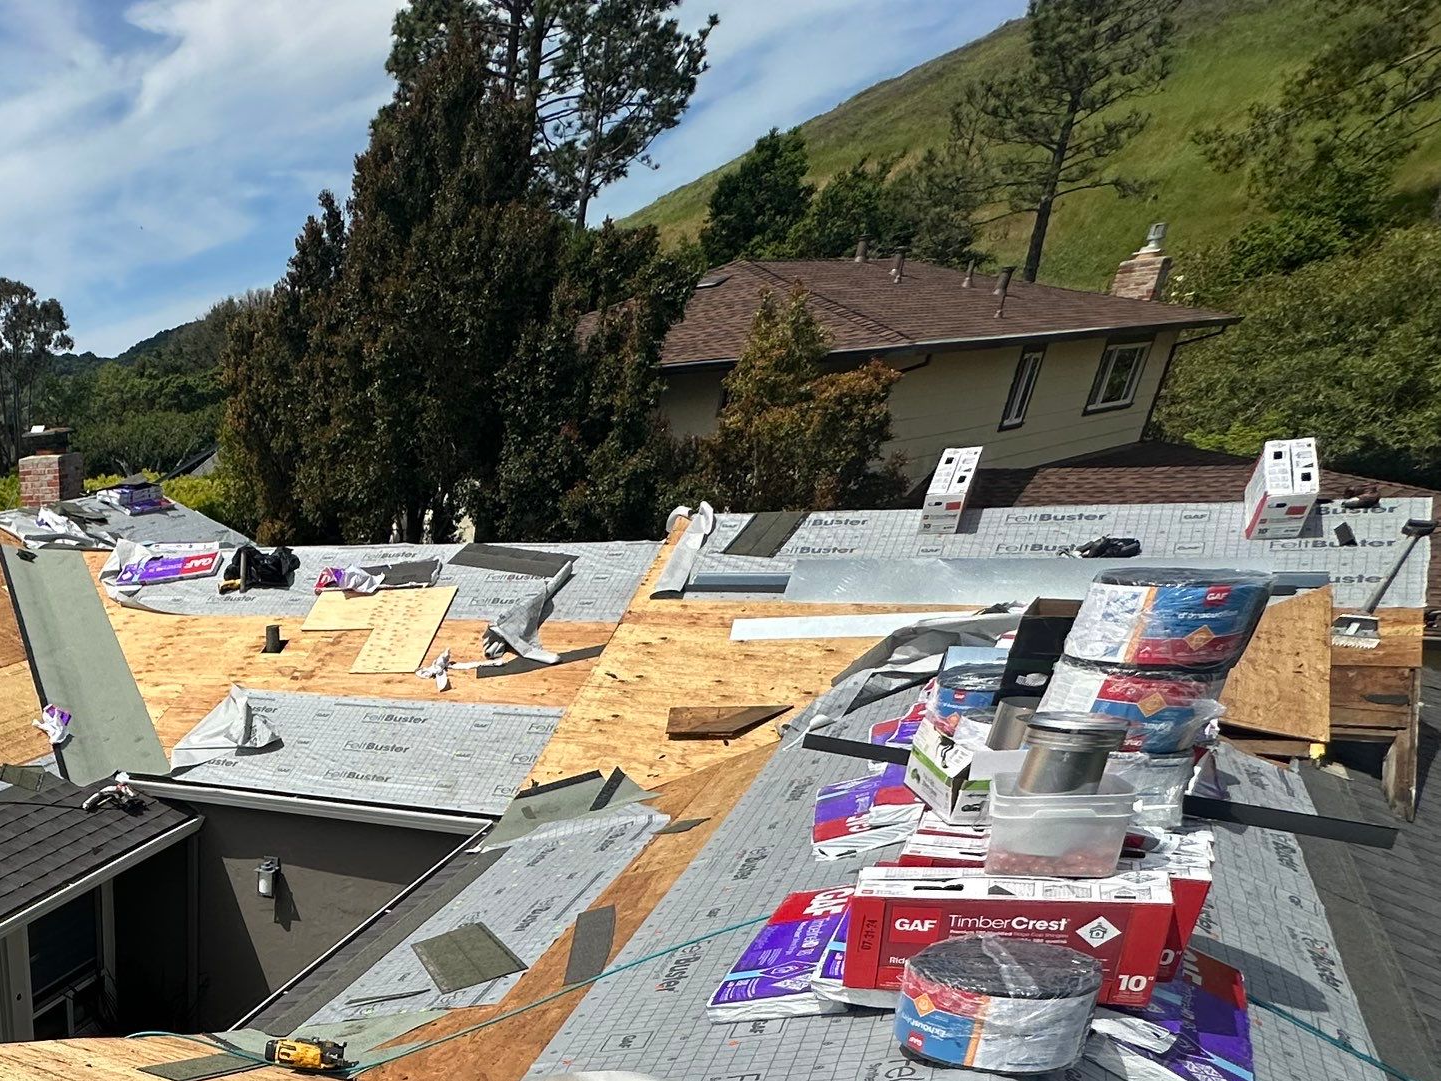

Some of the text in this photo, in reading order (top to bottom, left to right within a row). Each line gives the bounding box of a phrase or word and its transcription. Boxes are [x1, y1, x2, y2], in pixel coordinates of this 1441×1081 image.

[1006, 512, 1108, 524] FeltBuster
[996, 543, 1076, 554] FeltBust
[363, 712, 428, 724] FeltBuster
[343, 740, 410, 754] FeltBuster
[325, 769, 392, 783] FeltBuster
[895, 918, 937, 931] GAF
